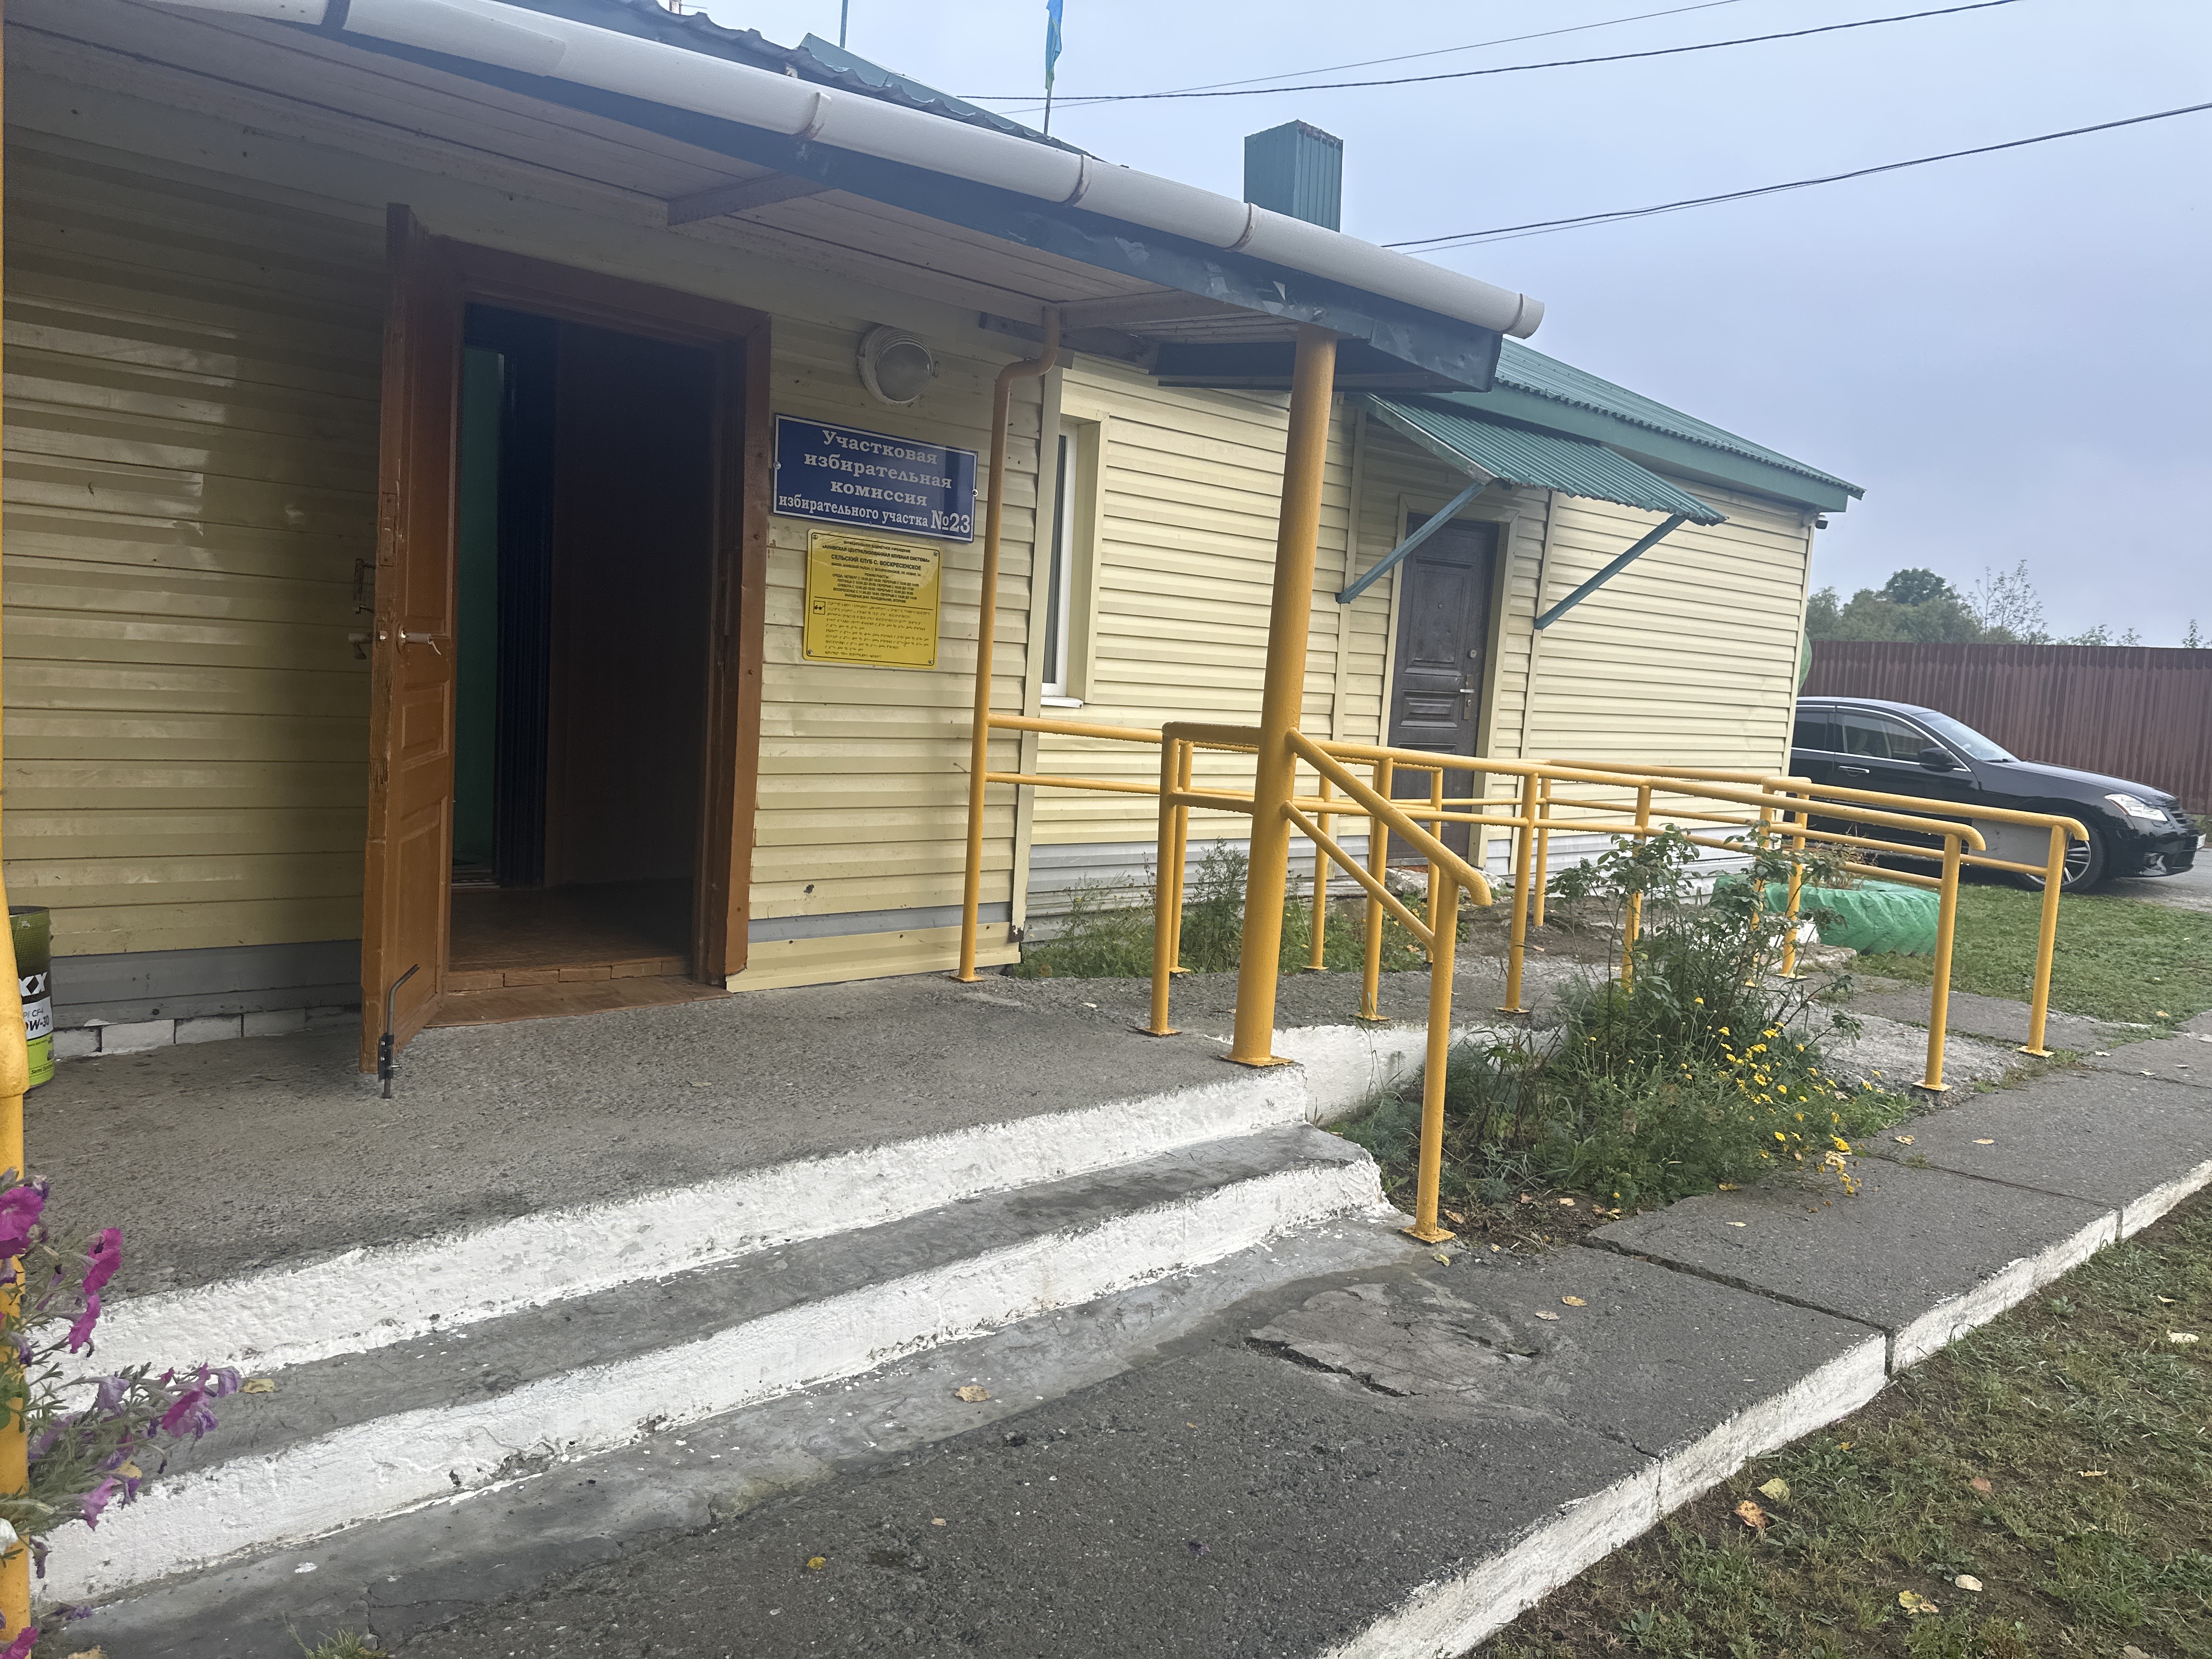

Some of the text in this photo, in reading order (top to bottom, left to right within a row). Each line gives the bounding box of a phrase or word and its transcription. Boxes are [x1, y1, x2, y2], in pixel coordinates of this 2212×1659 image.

[822, 430, 937, 465] Участковая
[804, 453, 952, 488] избирательная
[831, 481, 927, 506] комиссия
[779, 494, 970, 533] избирательного участка №23
[831, 554, 859, 562] СЕЛЬСКИЙ
[880, 561, 921, 571] ВОСКРЕСЕНСКОЕ
[848, 548, 890, 557] ЦЕНТРАЛИЗОВАННАЯ
[25, 1015, 49, 1031] W-30
